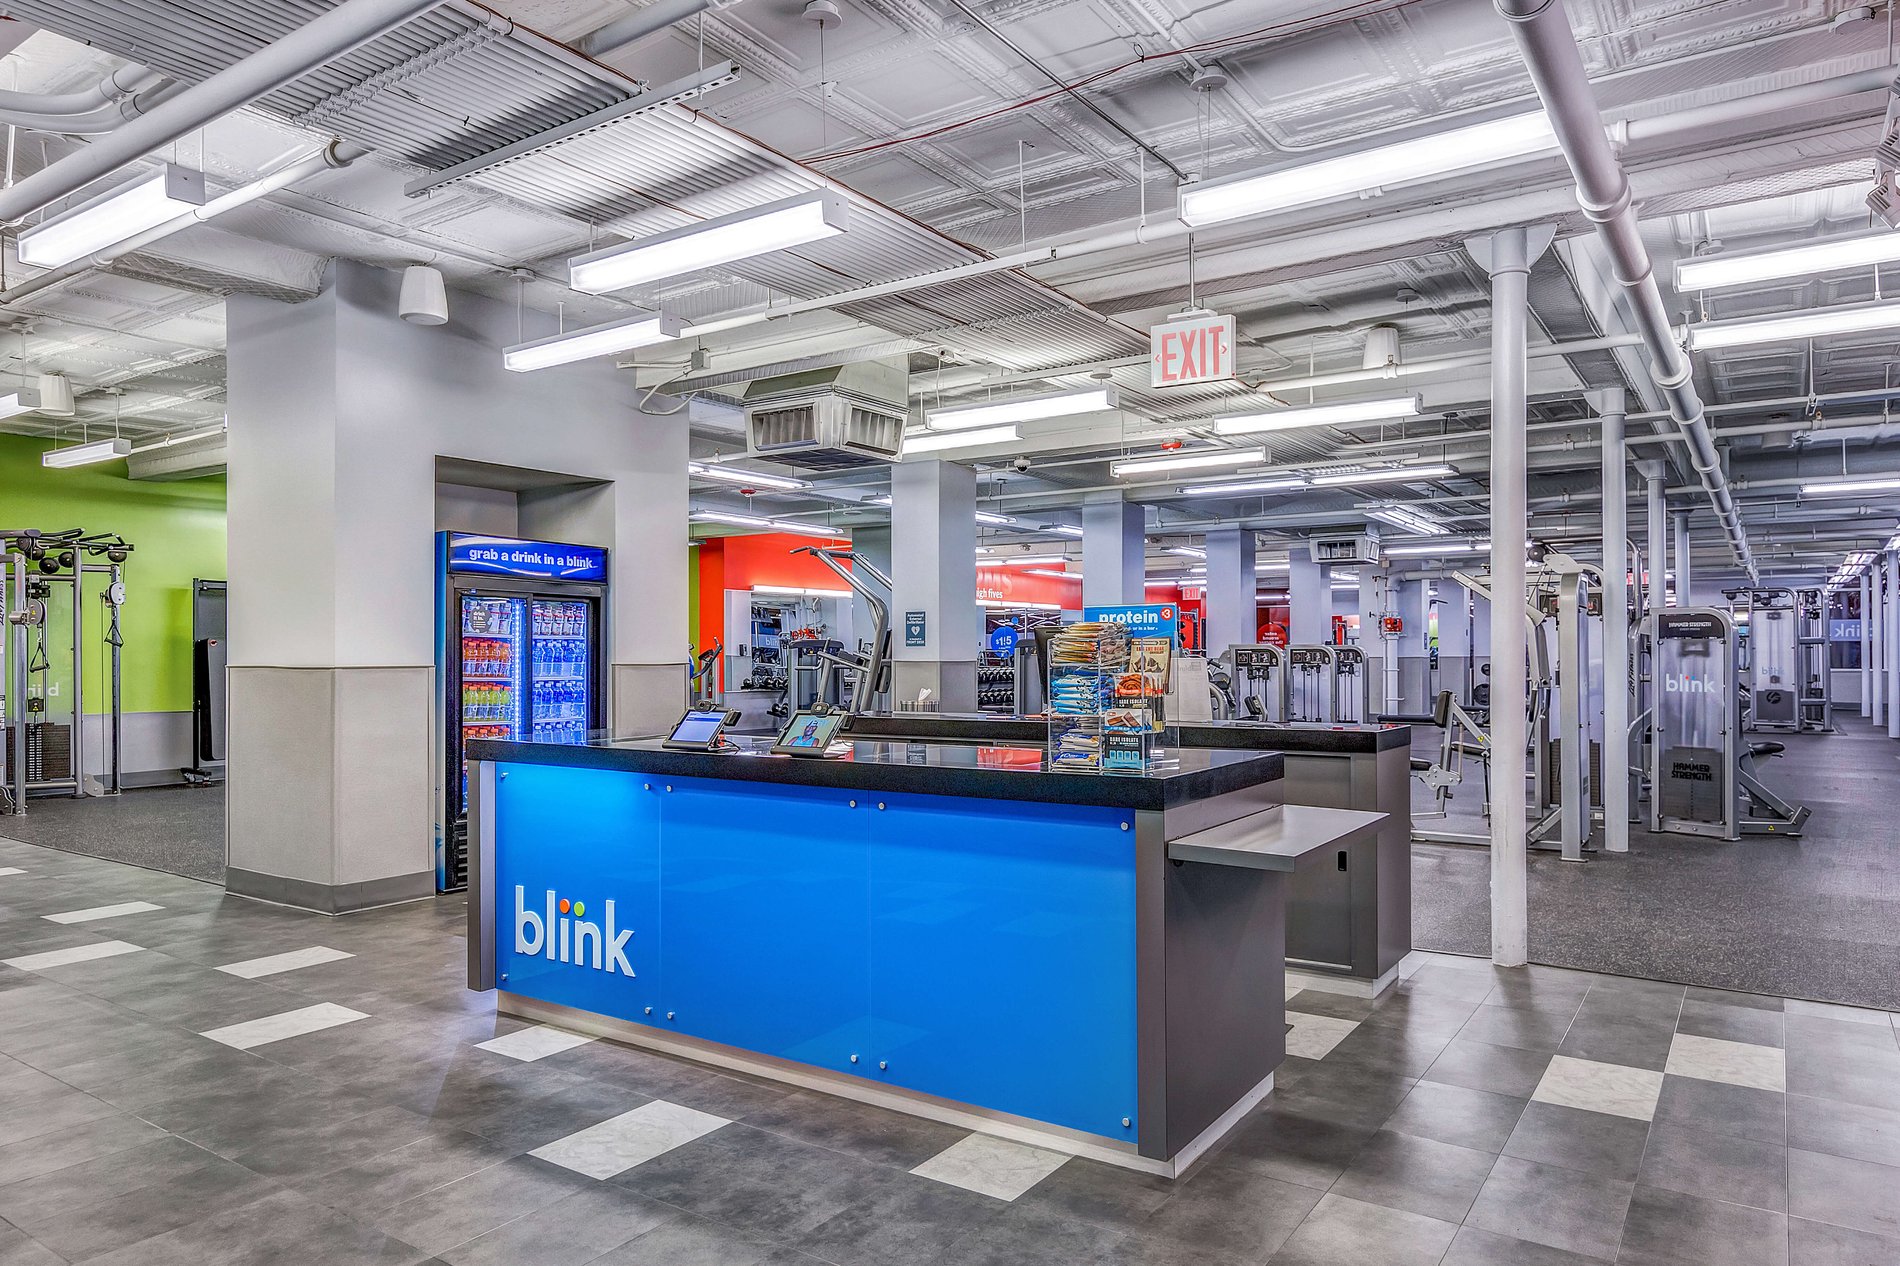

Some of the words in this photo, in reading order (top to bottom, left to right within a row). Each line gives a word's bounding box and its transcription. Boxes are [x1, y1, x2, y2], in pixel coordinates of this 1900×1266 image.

[1162, 325, 1224, 381] EXIT
[469, 548, 498, 560] grab
[501, 553, 509, 561] a
[511, 551, 541, 564] drink
[543, 553, 554, 565] in
[557, 557, 565, 566] a
[566, 556, 593, 568] blink
[988, 588, 1003, 598] fives
[1184, 588, 1199, 599] EXIT
[1099, 610, 1158, 623] protein
[1665, 673, 1715, 693] blink
[1672, 762, 1710, 773] HAMMER
[1671, 770, 1712, 782] STRENGTH
[515, 884, 636, 977] blink
